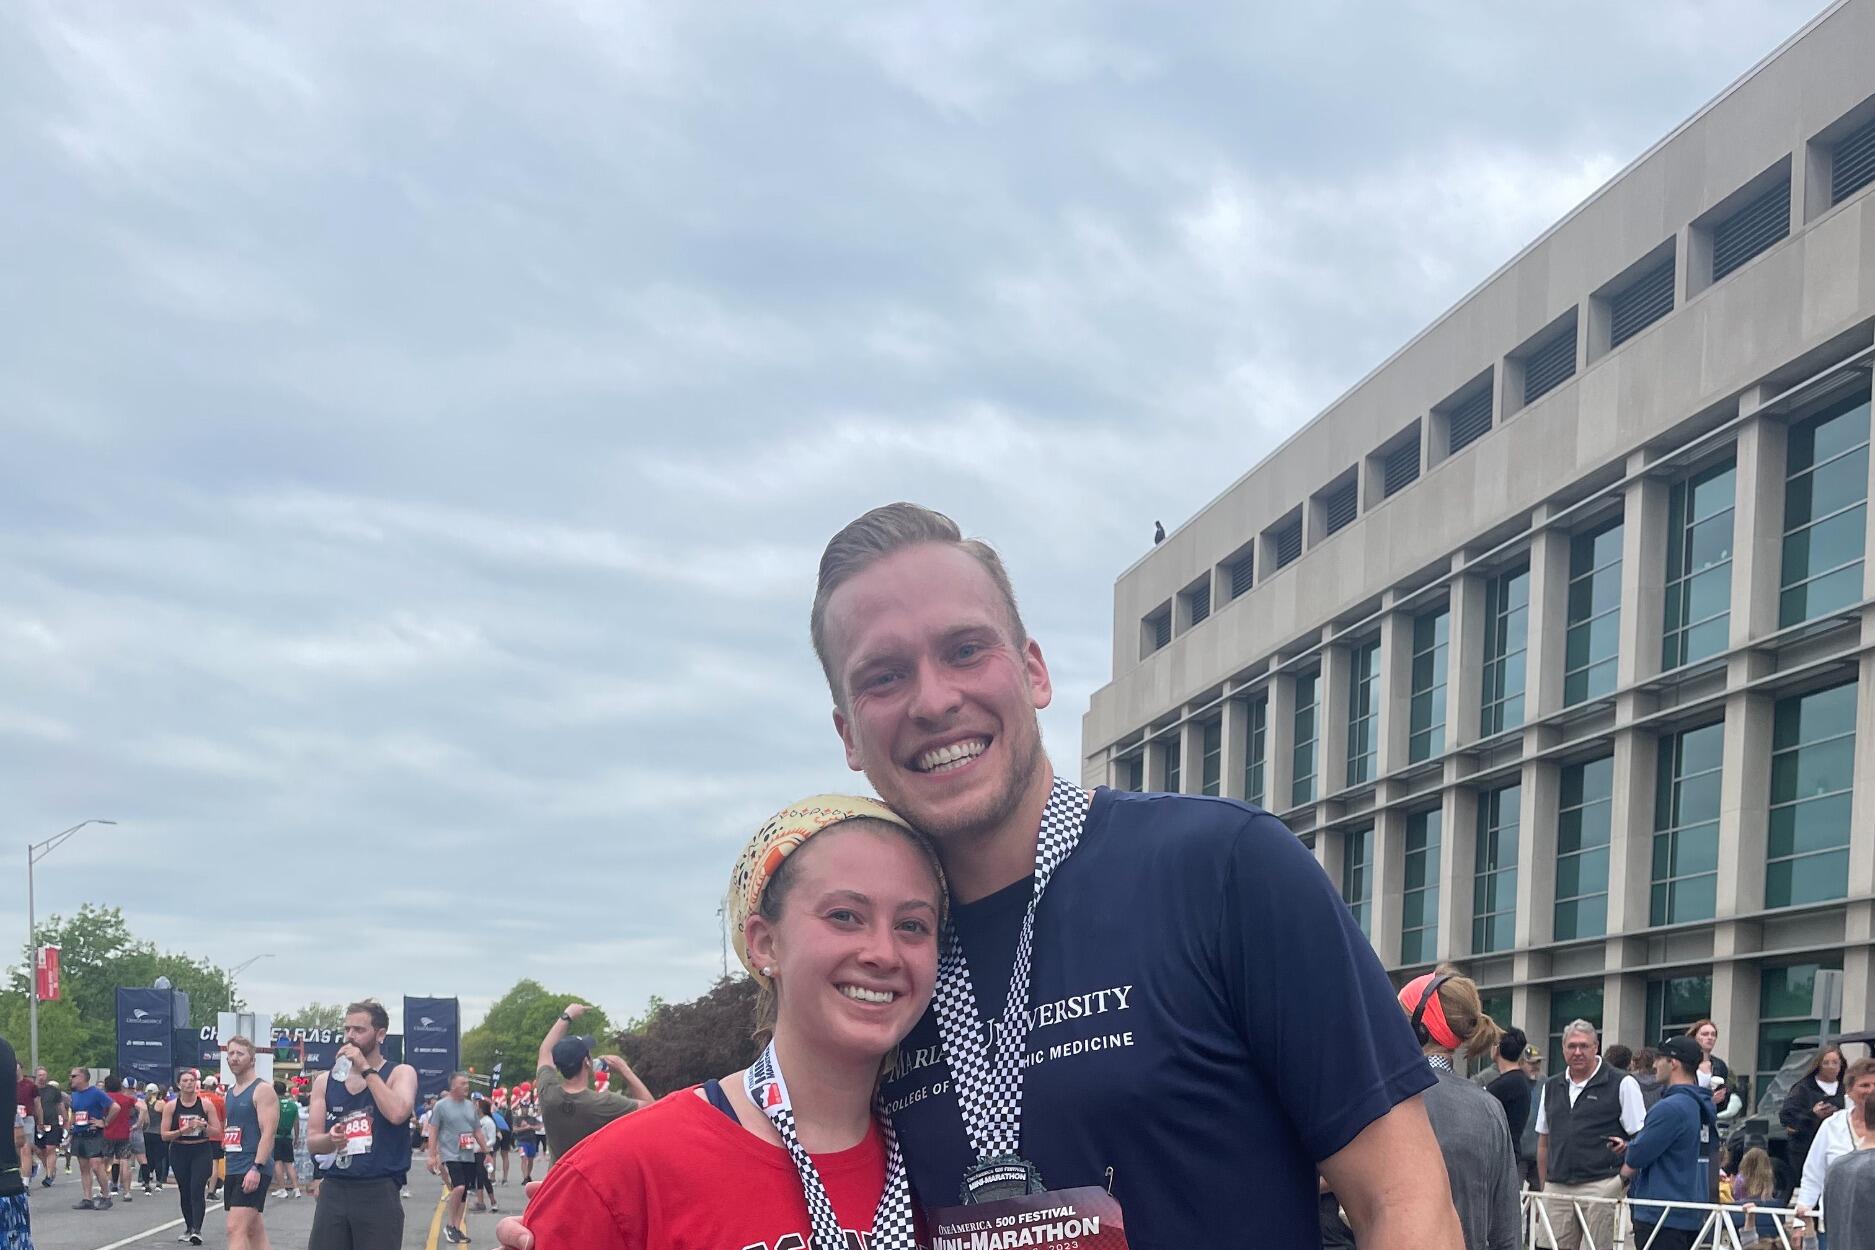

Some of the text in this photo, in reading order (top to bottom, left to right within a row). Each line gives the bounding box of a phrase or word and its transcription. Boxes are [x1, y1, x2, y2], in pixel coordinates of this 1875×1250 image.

[1050, 1031, 1134, 1061] MEDICINE
[886, 1044, 949, 1084] MARIA
[885, 1080, 949, 1114] COLLEGE OF
[995, 1216, 1016, 1228] 500
[1018, 1205, 1077, 1225] FESTIVAL
